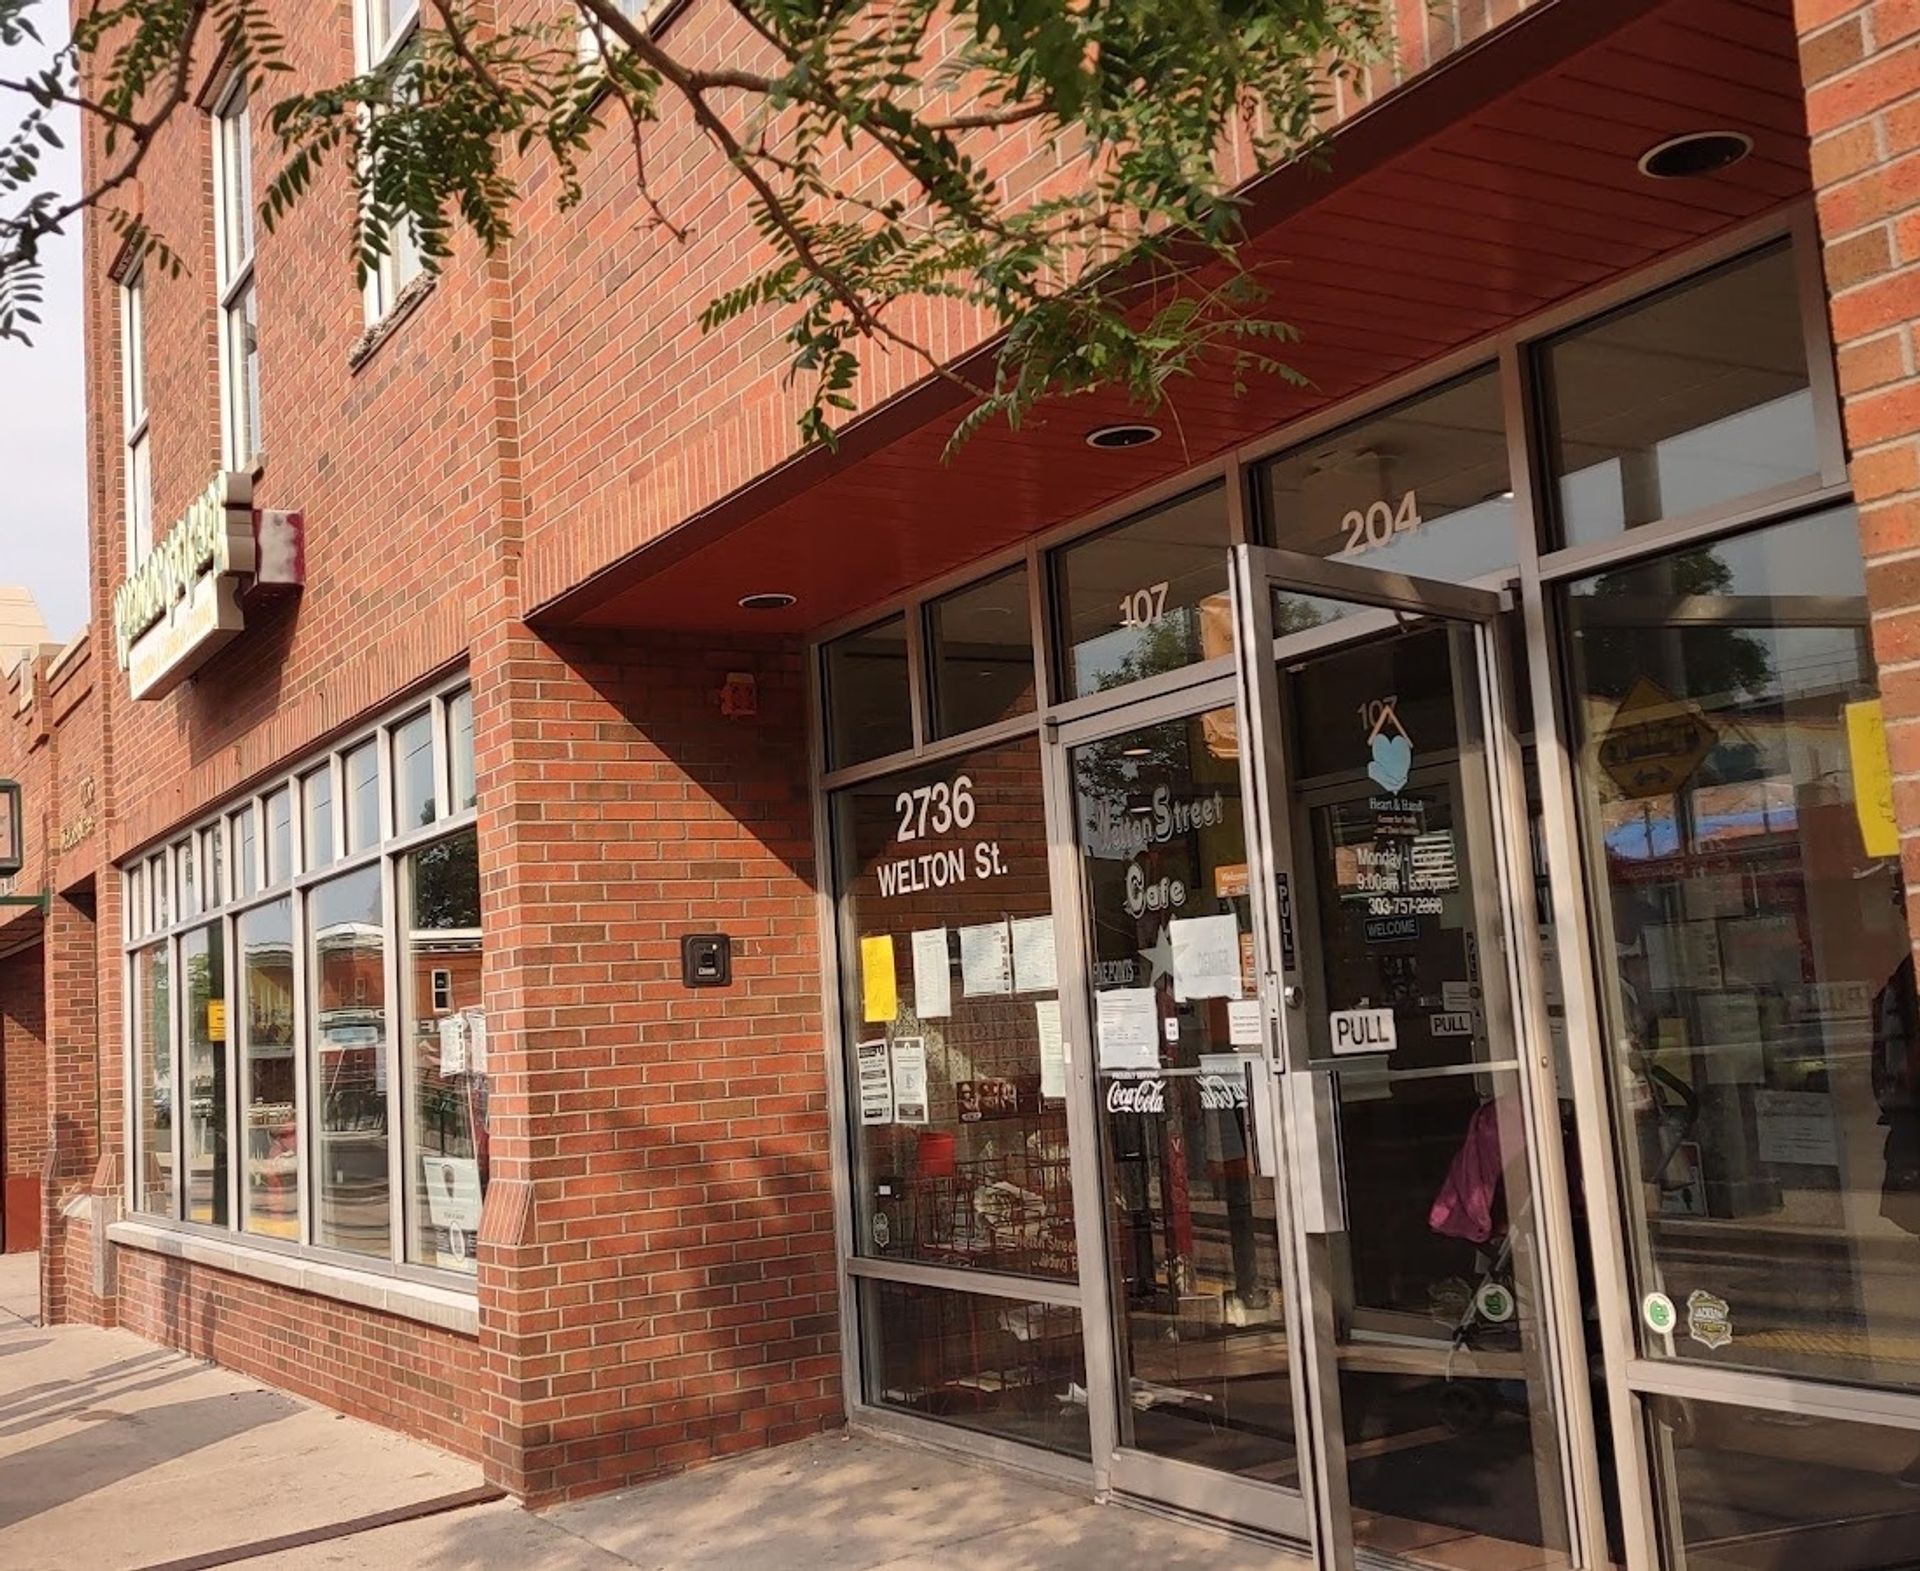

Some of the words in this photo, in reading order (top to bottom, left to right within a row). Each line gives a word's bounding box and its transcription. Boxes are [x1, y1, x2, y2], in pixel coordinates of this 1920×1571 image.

[1341, 490, 1422, 555] 204
[1119, 581, 1169, 630] 107
[895, 775, 975, 842] 2736
[1153, 785, 1223, 842] Street
[1369, 798, 1393, 811] Heart
[876, 848, 965, 897] WELTON
[974, 842, 1007, 879] St.
[1356, 848, 1402, 869] Monday
[1123, 863, 1186, 919] Cafe
[1279, 886, 1292, 950] PULL
[1367, 919, 1416, 936] WELCOME
[1337, 1015, 1390, 1045] PULL
[1434, 1016, 1468, 1032] PULL
